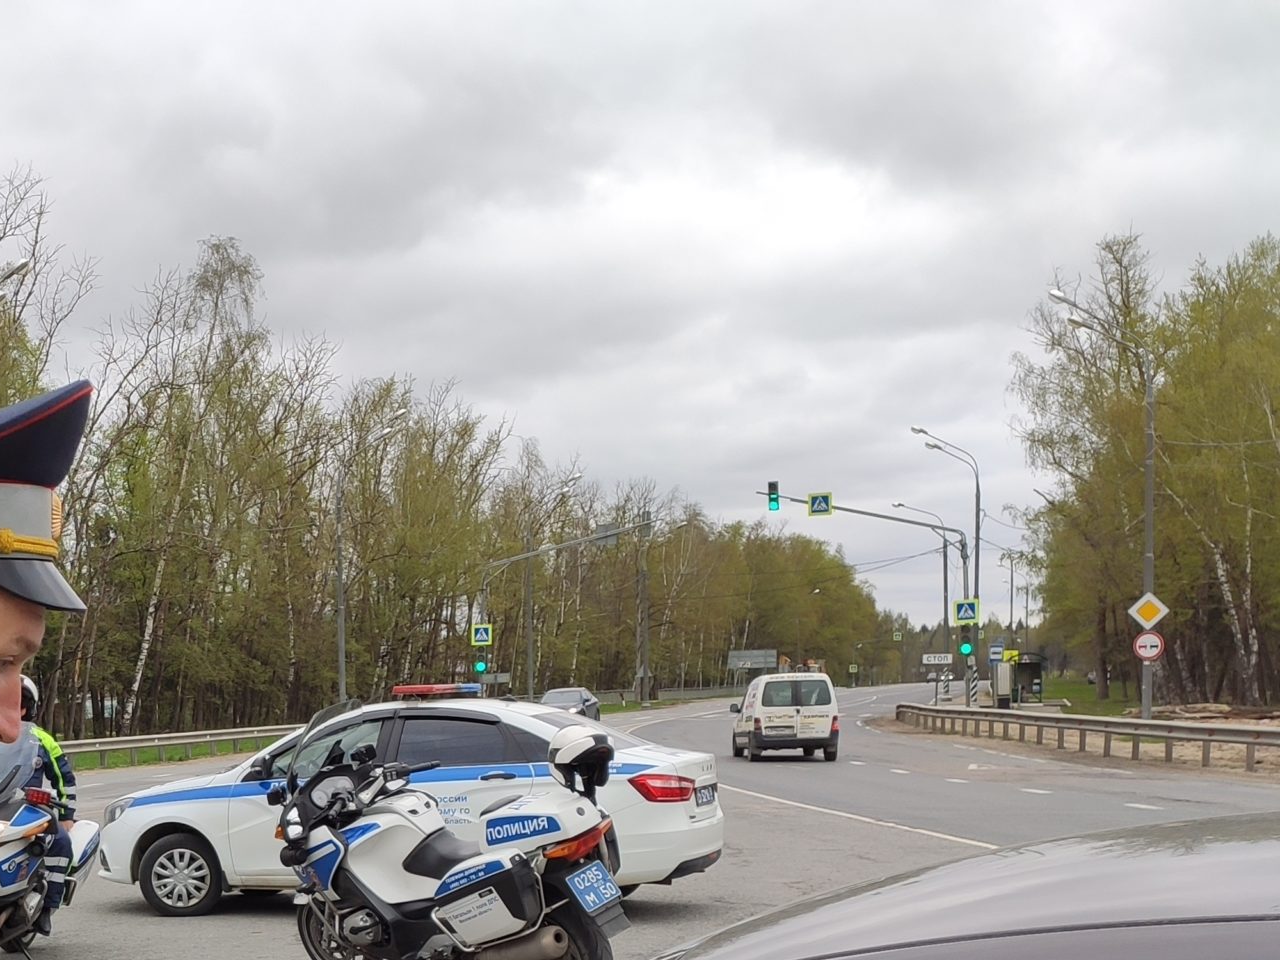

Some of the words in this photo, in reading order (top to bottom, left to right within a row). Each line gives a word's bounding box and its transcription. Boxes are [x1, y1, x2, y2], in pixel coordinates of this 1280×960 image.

[926, 654, 949, 663] СТОП
[486, 816, 549, 841] ПОЛИЦИЯ
[574, 866, 603, 890] 0285
[600, 883, 617, 899] 50
